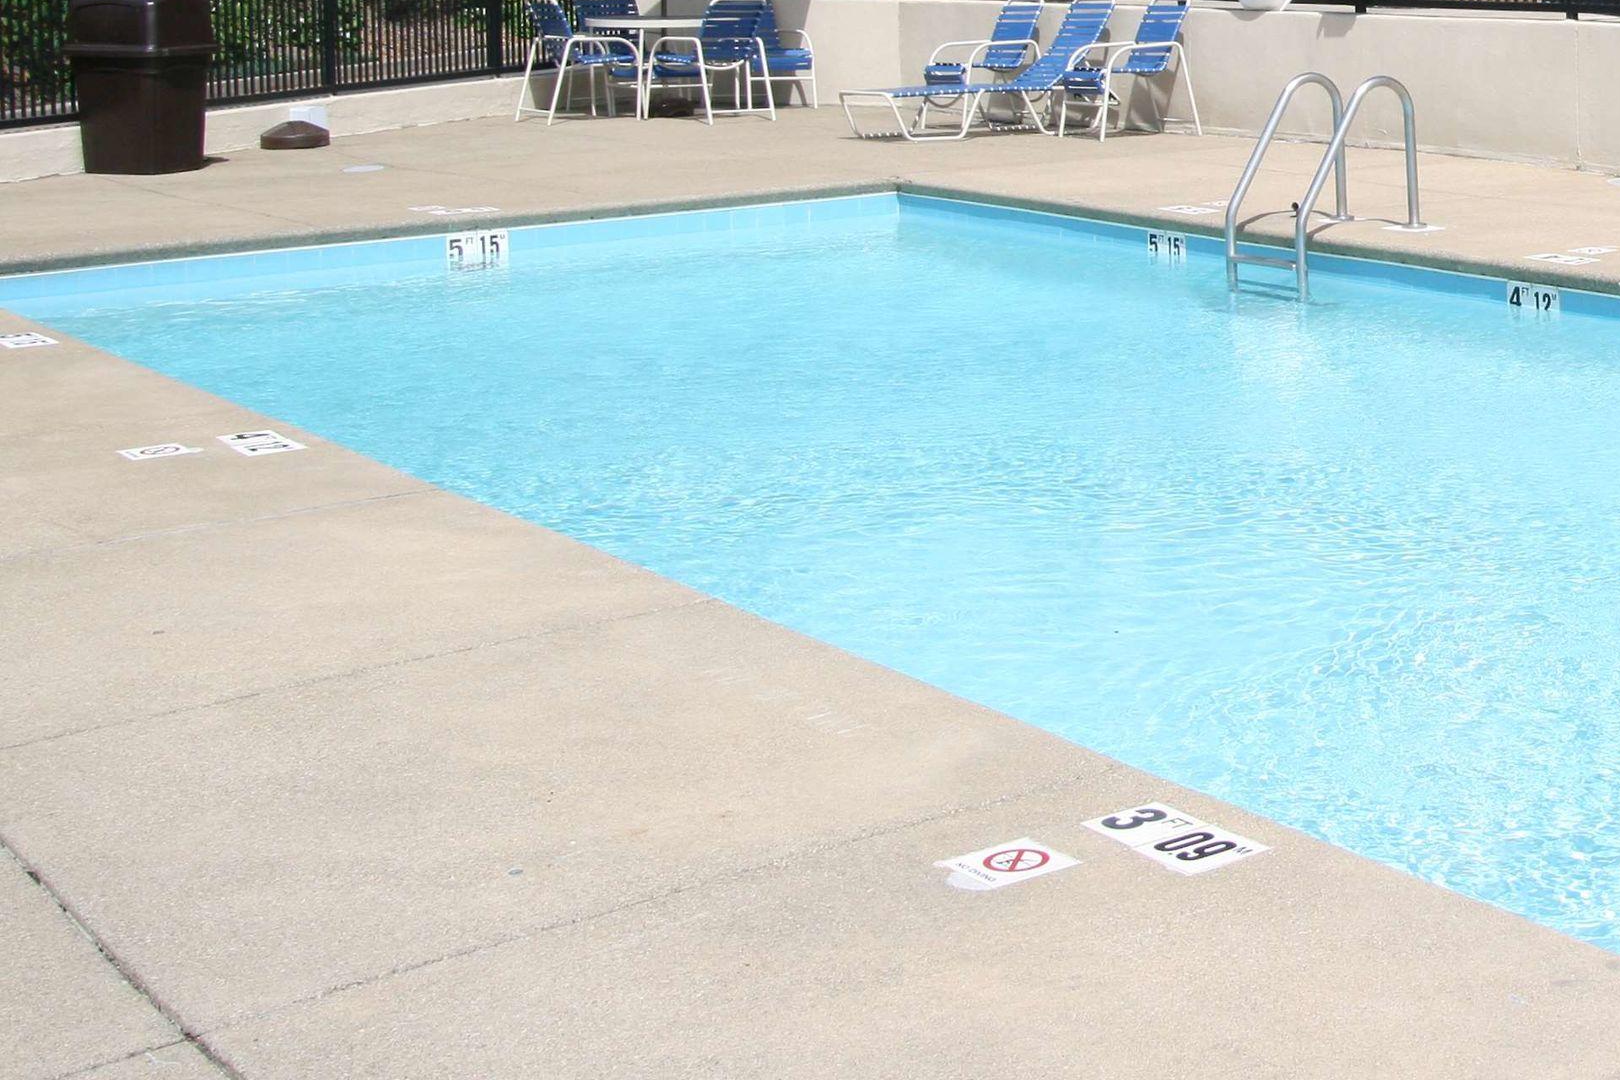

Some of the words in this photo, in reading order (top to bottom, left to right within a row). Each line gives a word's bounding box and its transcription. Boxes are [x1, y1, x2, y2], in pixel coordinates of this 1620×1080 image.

[449, 238, 464, 261] 5
[480, 234, 500, 261] 15
[1149, 233, 1159, 253] 5
[1167, 236, 1180, 256] 15
[1509, 286, 1522, 307] 4
[1521, 286, 1530, 297] FT
[1101, 808, 1168, 830] 3
[1161, 817, 1194, 829] FT
